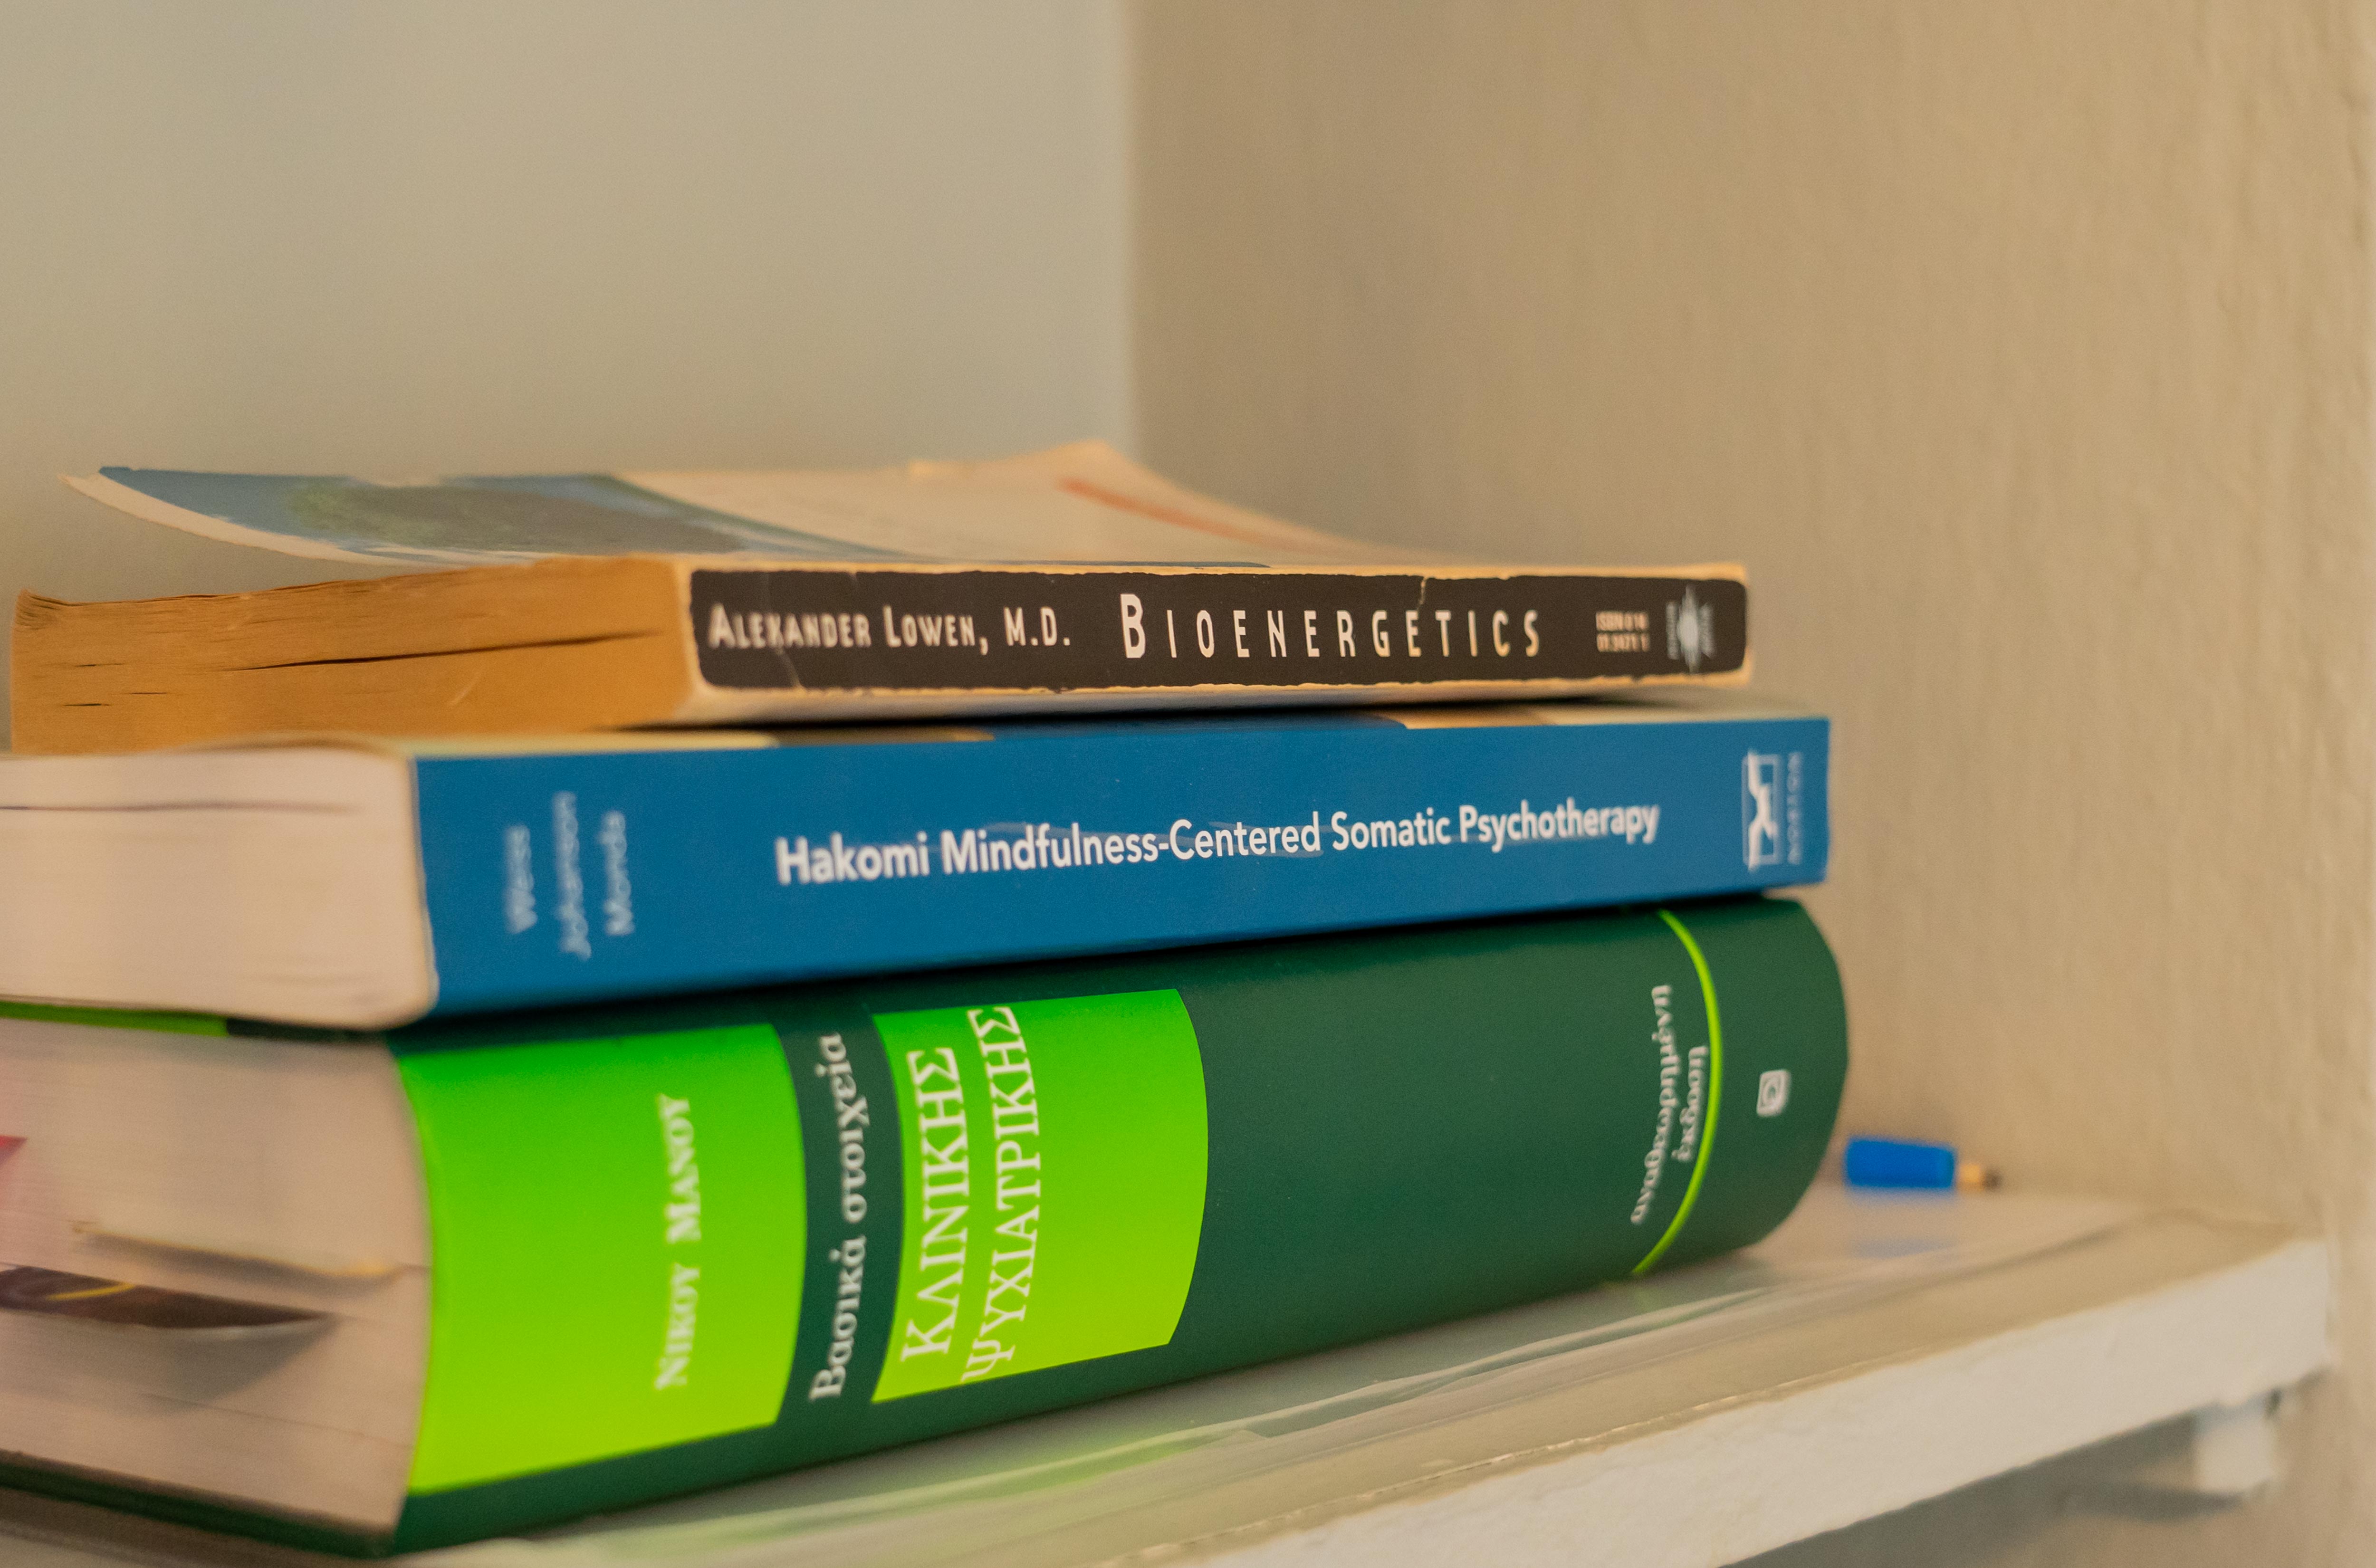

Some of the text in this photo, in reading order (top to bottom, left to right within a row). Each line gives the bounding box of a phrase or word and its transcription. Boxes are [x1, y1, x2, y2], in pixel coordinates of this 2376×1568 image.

[706, 602, 1070, 655] ALEXANDER LOWEN, M.D.
[1120, 593, 1540, 659] BIOENERGETICS
[775, 796, 1660, 885] Hakomi Mindfulness-Centered Somatic Psychotherapy
[809, 1032, 871, 1403] Βασικά στοιχεία
[901, 1047, 970, 1362] ΚΛΙΝΙΚΗΣ
[960, 1005, 1041, 1384] ΨΥΧΙΑΤΡΙΚΗΣ
